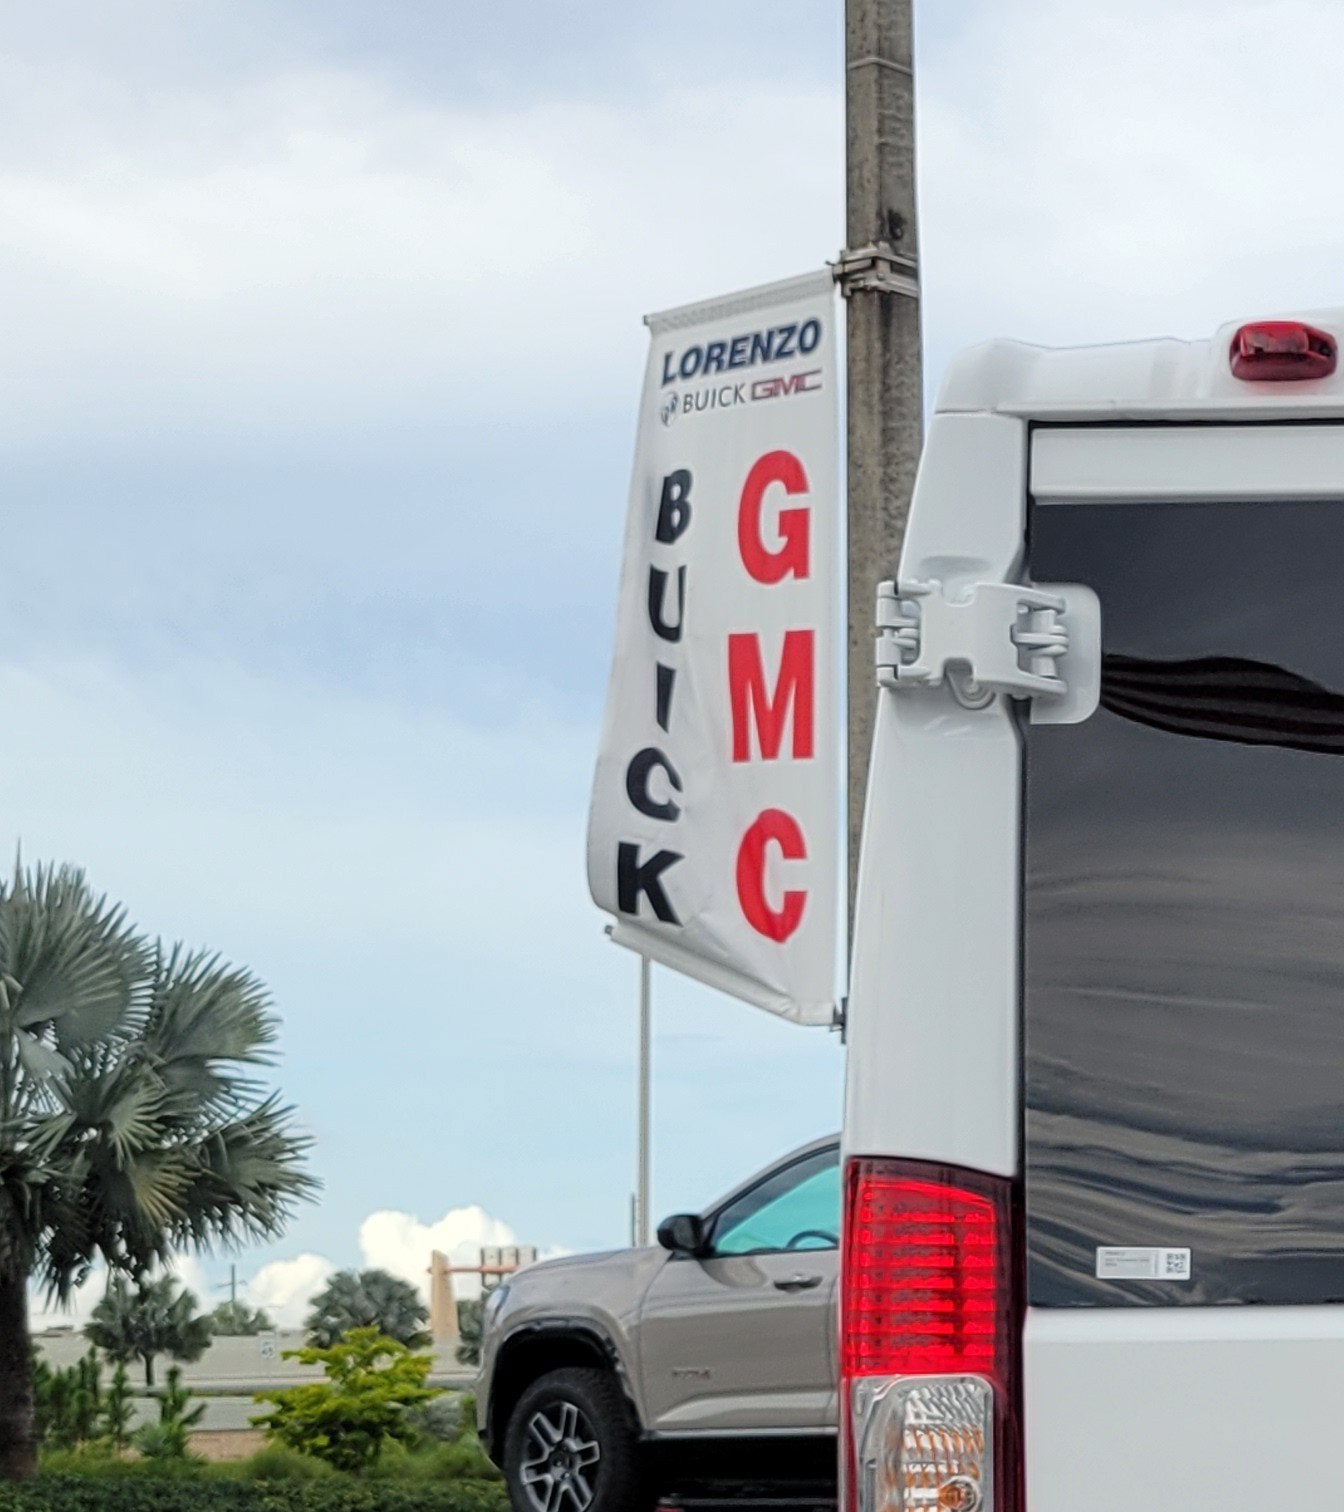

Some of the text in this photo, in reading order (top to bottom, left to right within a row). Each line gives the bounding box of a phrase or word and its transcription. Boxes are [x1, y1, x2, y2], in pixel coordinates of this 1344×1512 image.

[661, 317, 822, 387] LORENZO
[682, 368, 823, 415] BUICK GMC
[617, 468, 694, 928] BUICK
[728, 449, 816, 945] GMC
